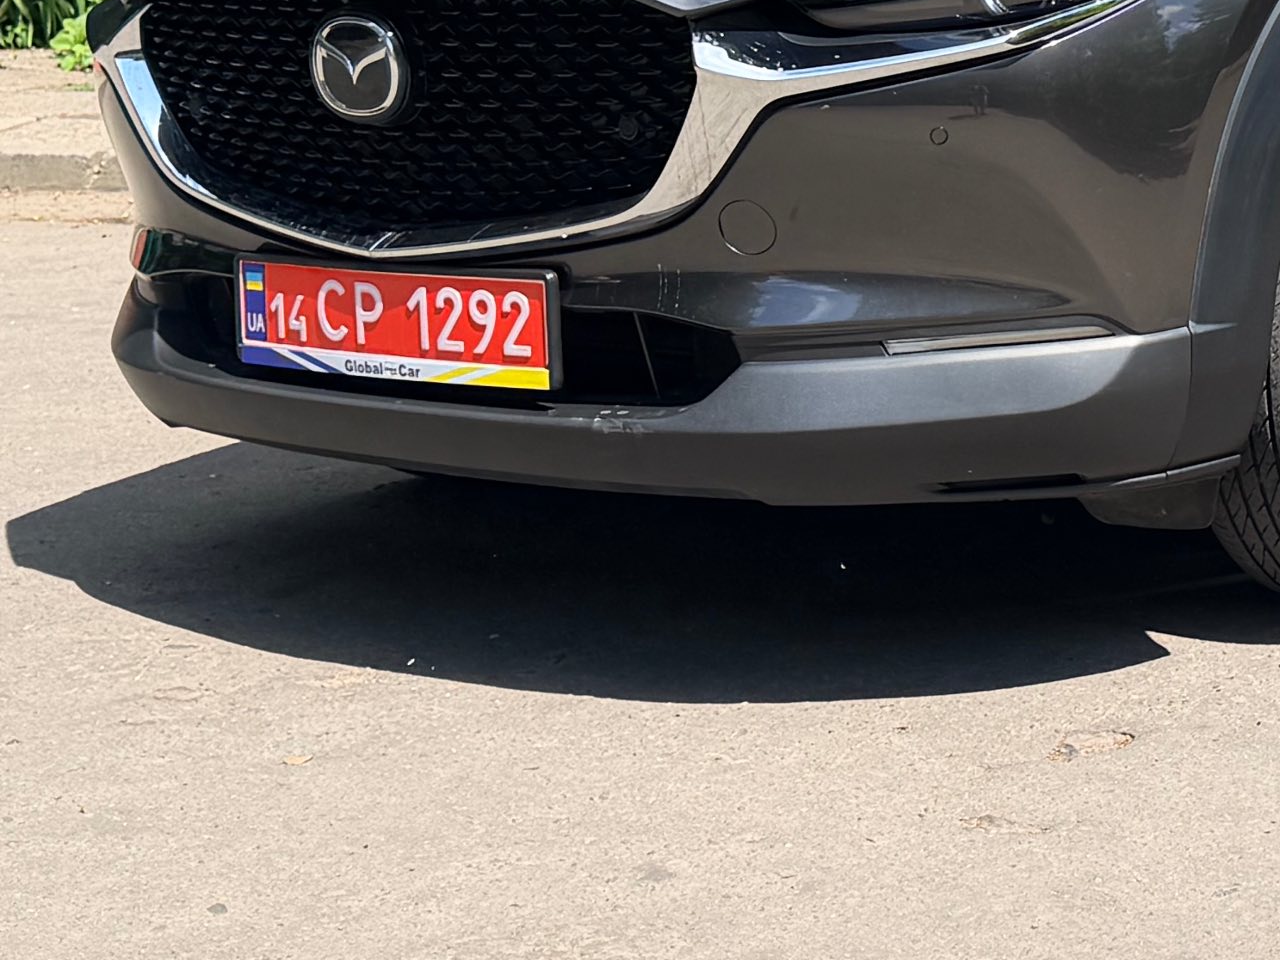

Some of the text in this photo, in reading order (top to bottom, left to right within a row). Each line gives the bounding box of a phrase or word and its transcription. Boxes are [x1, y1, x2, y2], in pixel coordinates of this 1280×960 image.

[247, 312, 265, 333] UA
[406, 286, 532, 357] 1292
[344, 359, 383, 375] Global
[398, 364, 421, 378] Car
